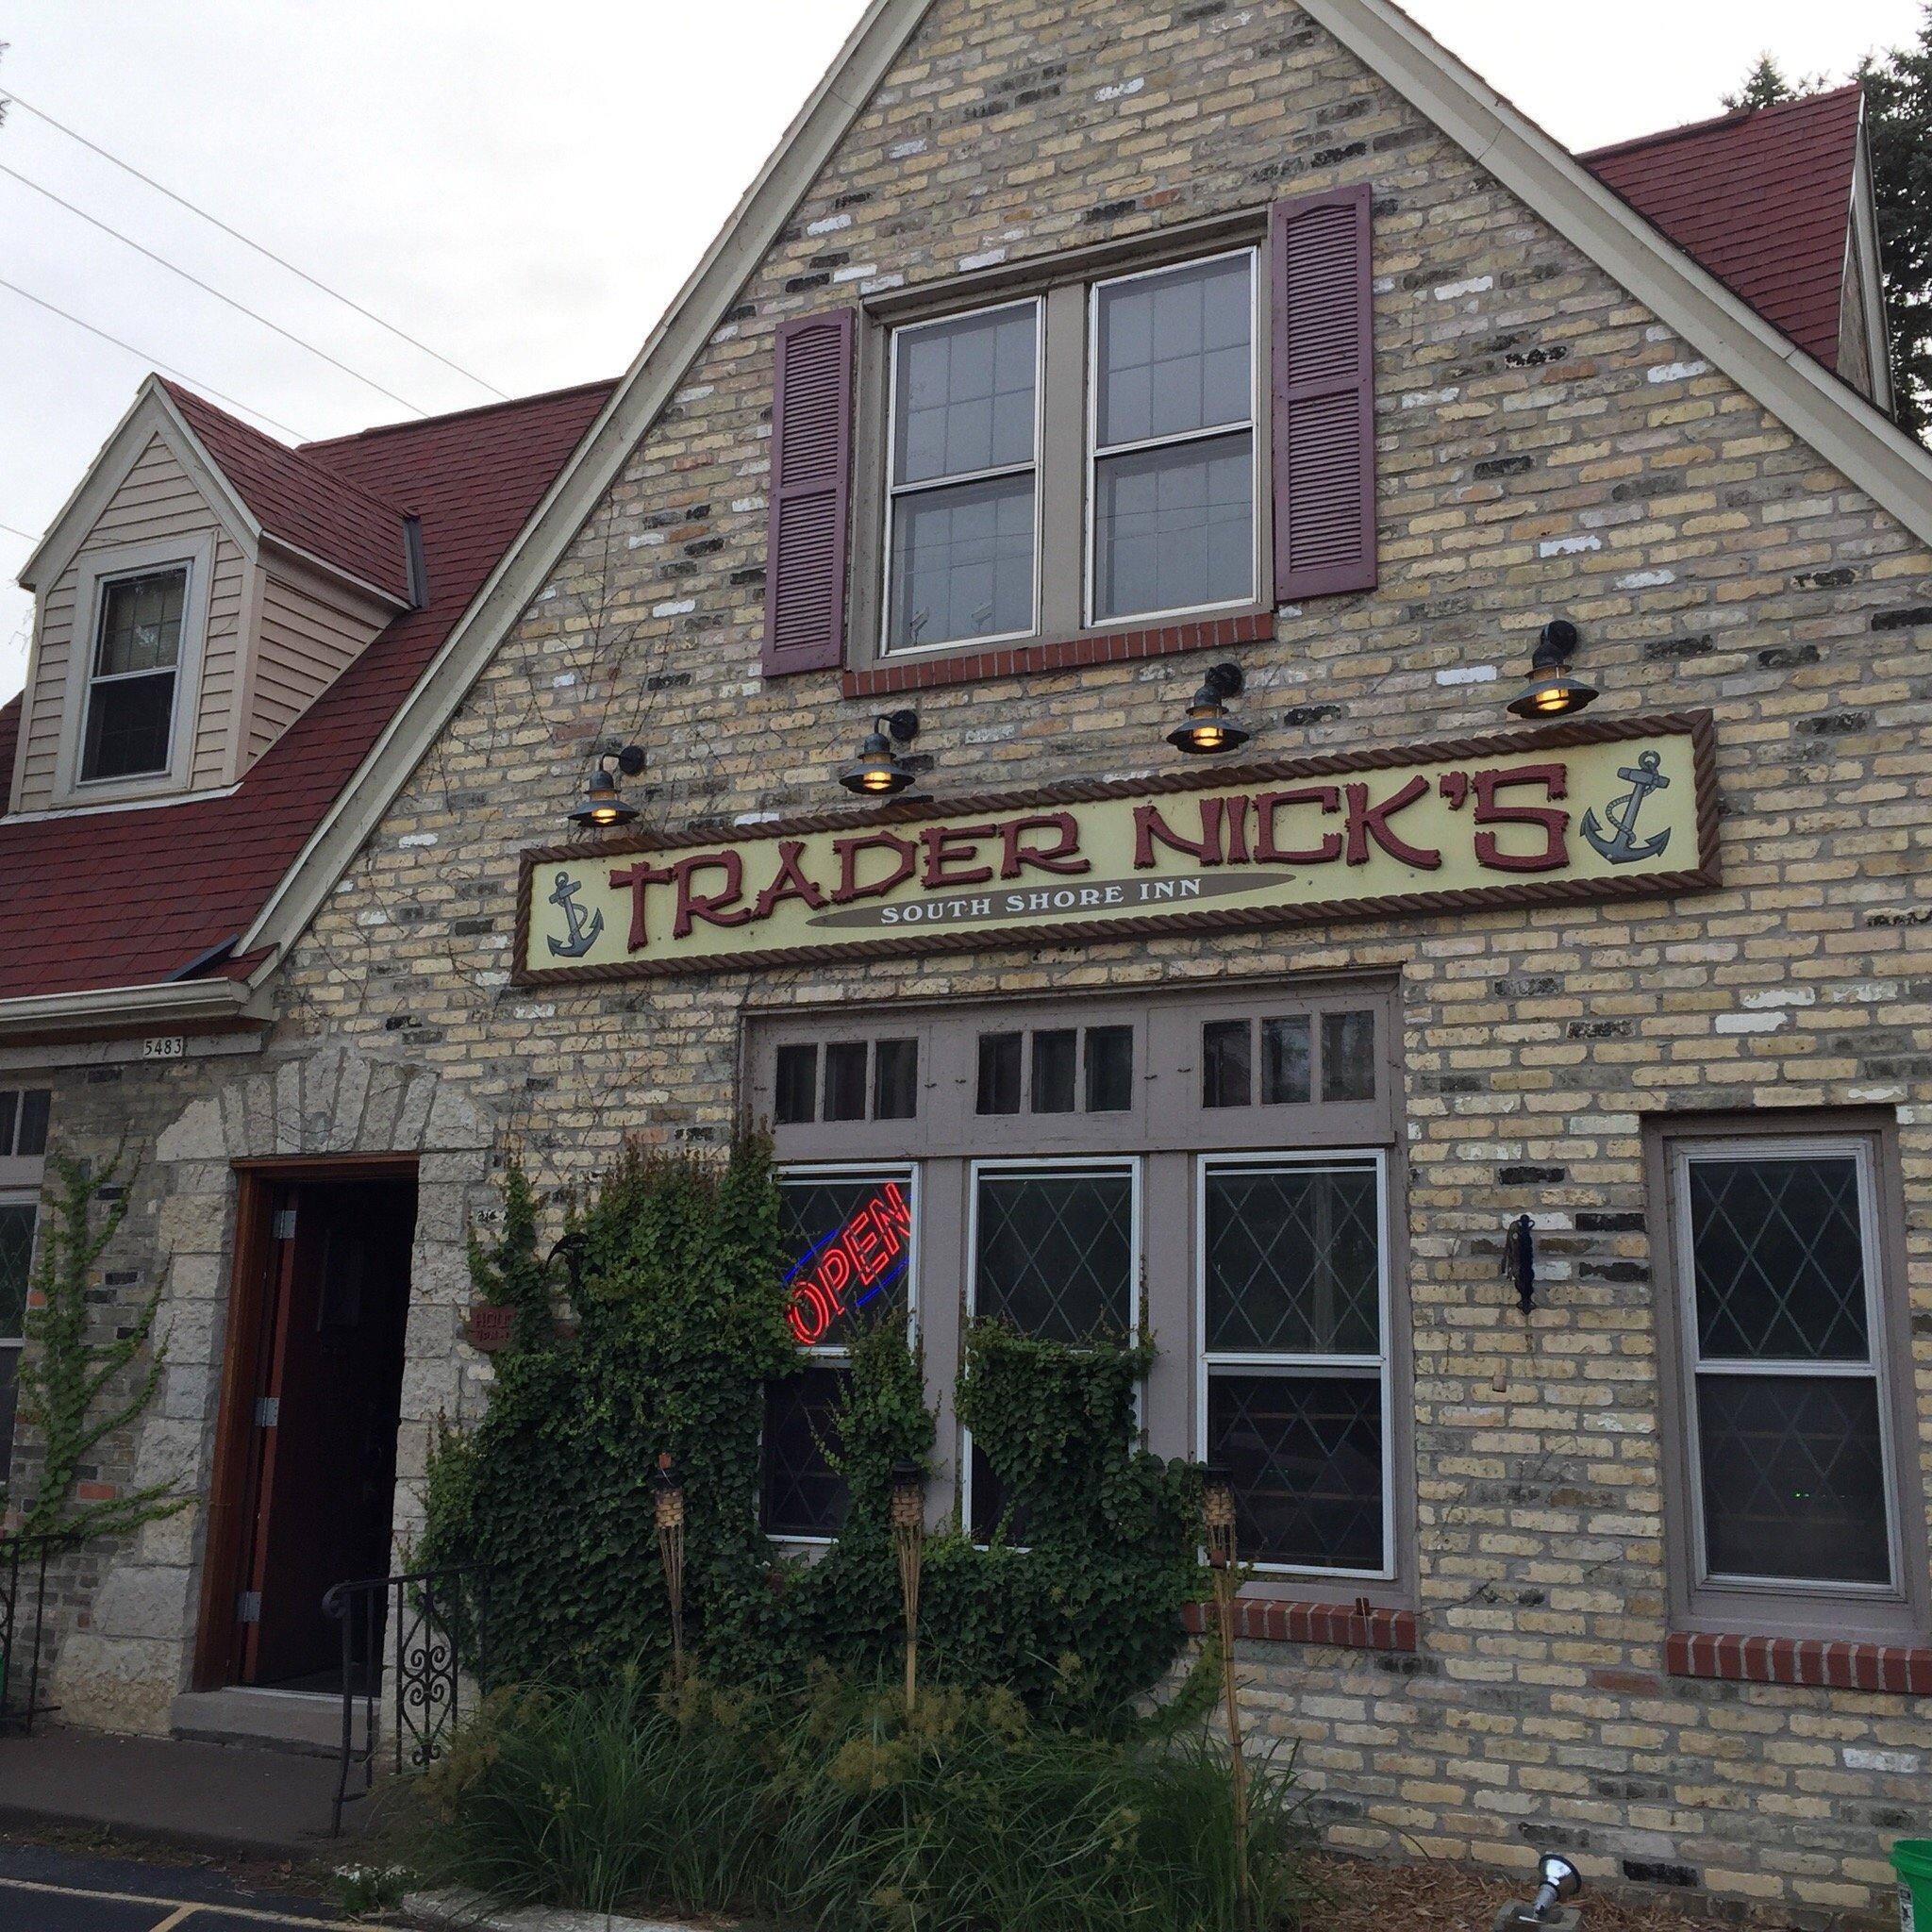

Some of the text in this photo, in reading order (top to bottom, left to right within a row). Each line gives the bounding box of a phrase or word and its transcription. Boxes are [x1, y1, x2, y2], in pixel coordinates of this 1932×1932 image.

[608, 763, 1571, 953] TRADER NICK'S
[880, 878, 1202, 924] SOUTH SHORE INN
[144, 1038, 183, 1057] 5483
[787, 1181, 911, 1345] OPEN
